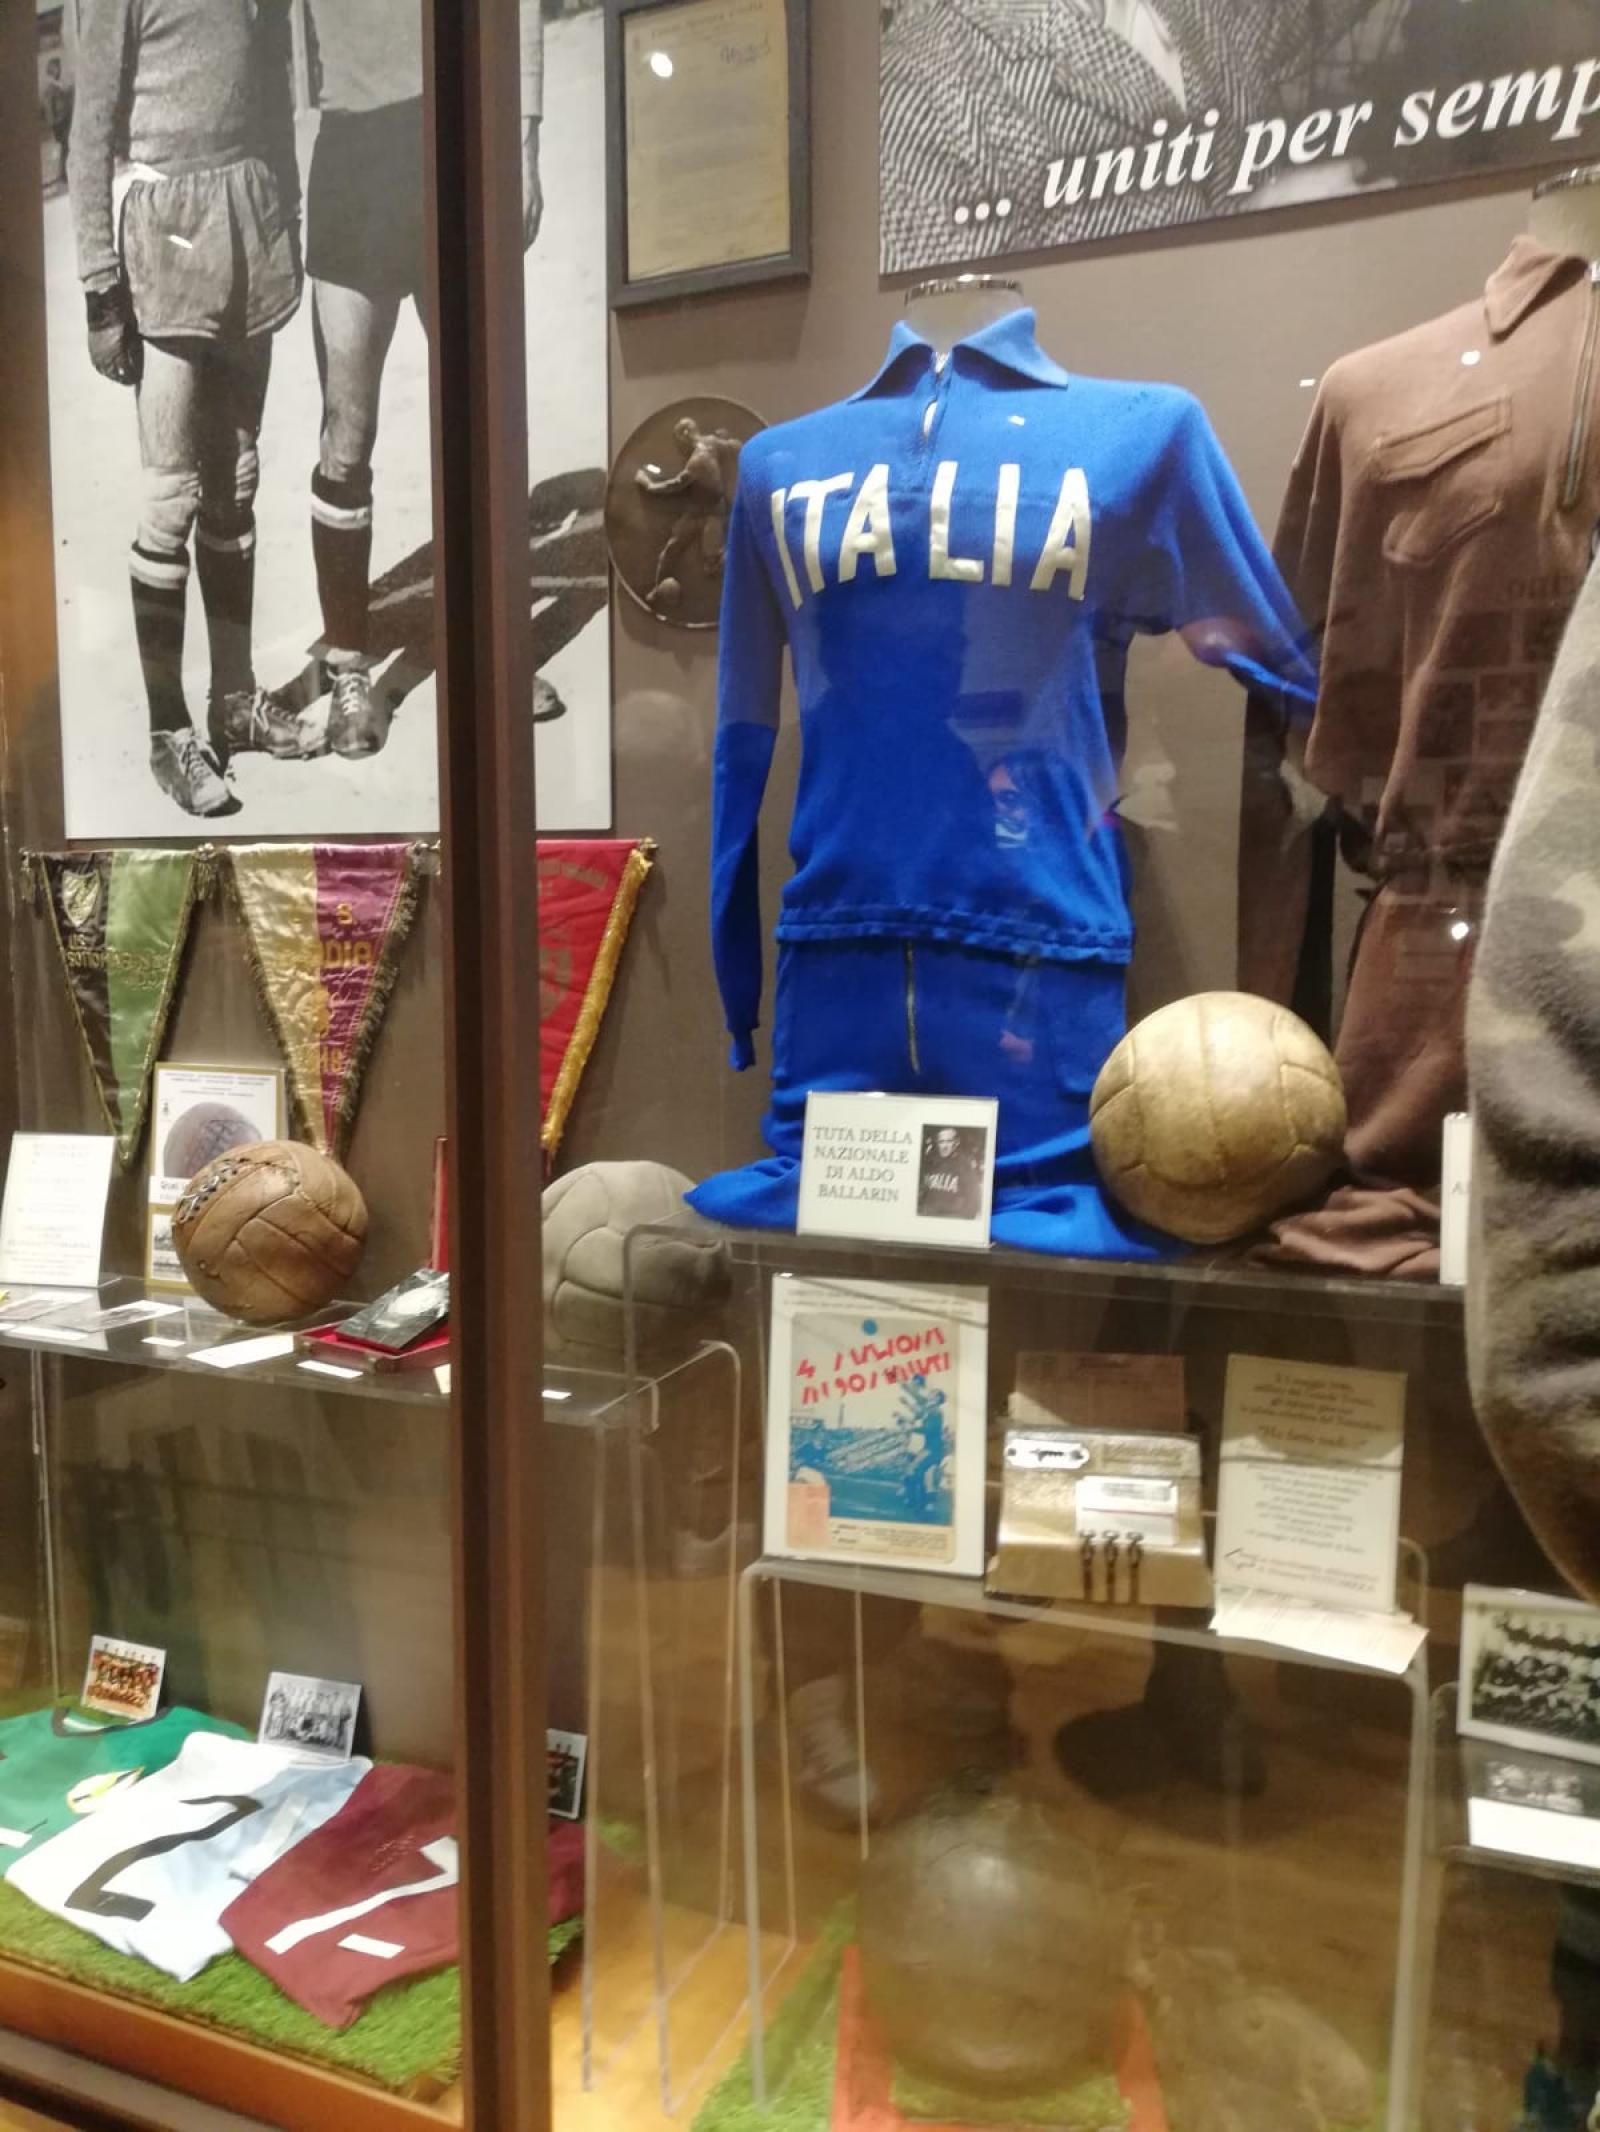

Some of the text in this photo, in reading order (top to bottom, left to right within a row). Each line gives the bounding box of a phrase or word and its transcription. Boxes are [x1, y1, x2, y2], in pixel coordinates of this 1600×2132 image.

[1042, 108, 1219, 209] uniti
[1225, 101, 1373, 194] per
[771, 460, 1092, 611] ITALIA
[812, 1126, 913, 1145] TUTA DELLA
[814, 1145, 910, 1164] NAZIONALE
[825, 1165, 895, 1183] DI ALDO
[818, 1184, 899, 1202] BALLARIN
